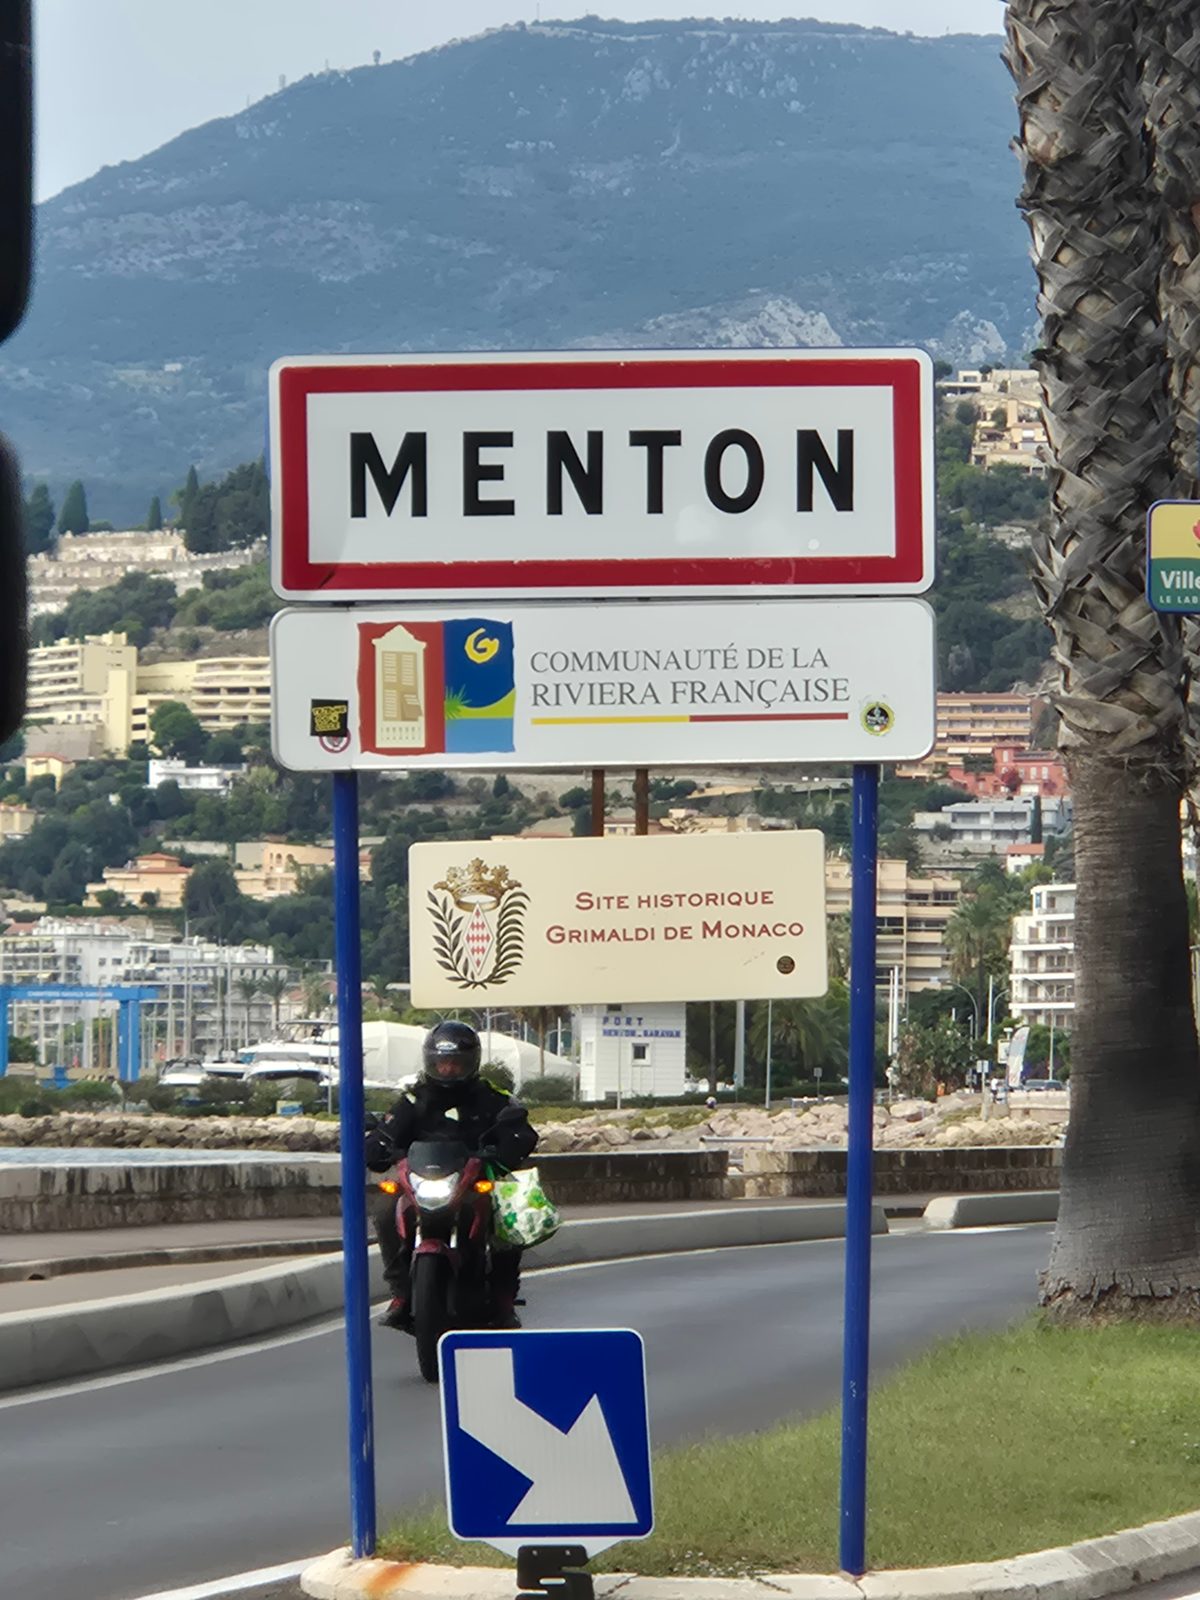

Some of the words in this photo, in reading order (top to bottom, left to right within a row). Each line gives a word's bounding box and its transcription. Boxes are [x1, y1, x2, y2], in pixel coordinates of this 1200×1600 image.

[349, 428, 854, 518] MENTON
[1159, 595, 1171, 604] LE
[530, 642, 739, 673] COMMUNAUTÉ
[746, 647, 784, 669] DE
[792, 647, 829, 669] LA
[531, 682, 661, 707] RIVIERA
[671, 678, 850, 709] FRANÇAISE
[603, 1017, 643, 1025] PORT
